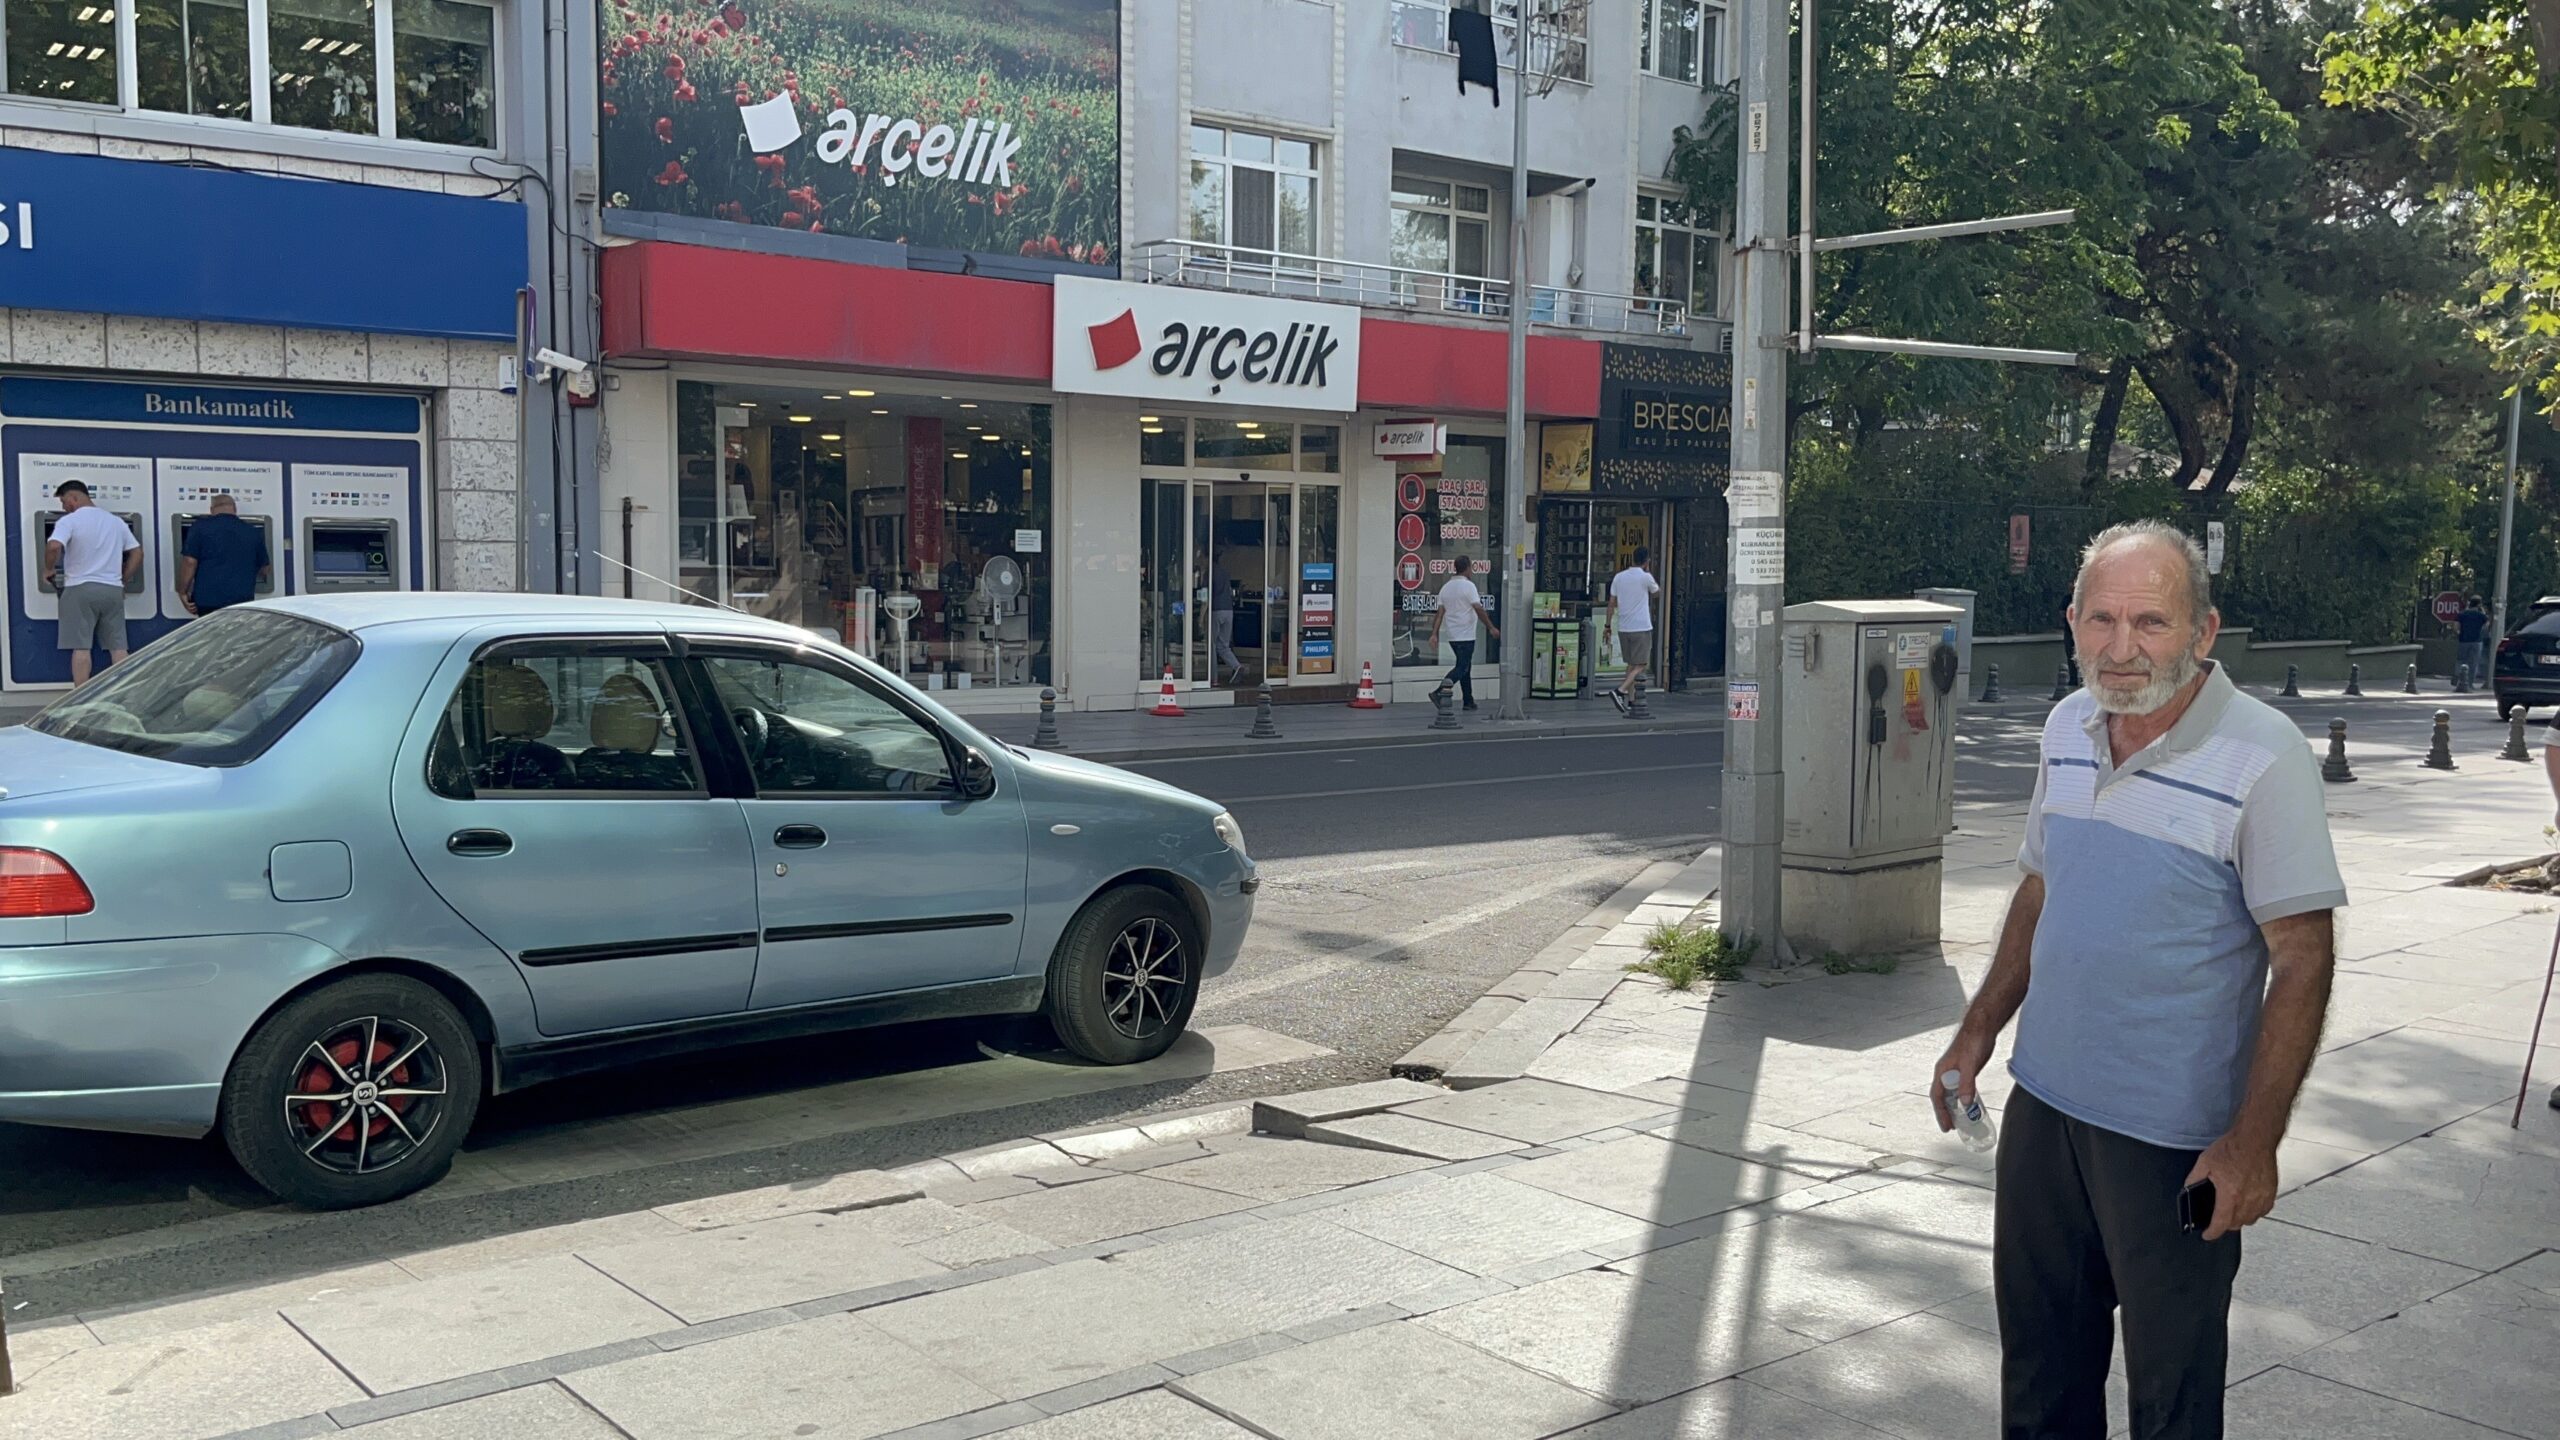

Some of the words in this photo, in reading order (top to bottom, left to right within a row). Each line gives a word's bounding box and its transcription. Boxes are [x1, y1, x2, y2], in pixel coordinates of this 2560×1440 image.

[817, 108, 1022, 188] arçelik
[1151, 321, 1339, 396] arçelik
[145, 393, 295, 419] Bankamatik
[1634, 401, 1731, 433] BRESCIA
[1390, 431, 1425, 447] arçelik
[1437, 479, 1461, 495] ARAÇ
[1440, 524, 1480, 539] SCOOTER
[1621, 520, 1628, 546] 3
[1629, 525, 1644, 546] GÜN
[1429, 559, 1447, 574] CEP
[2436, 601, 2460, 614] DUR
[1305, 614, 1329, 622] Lenovo
